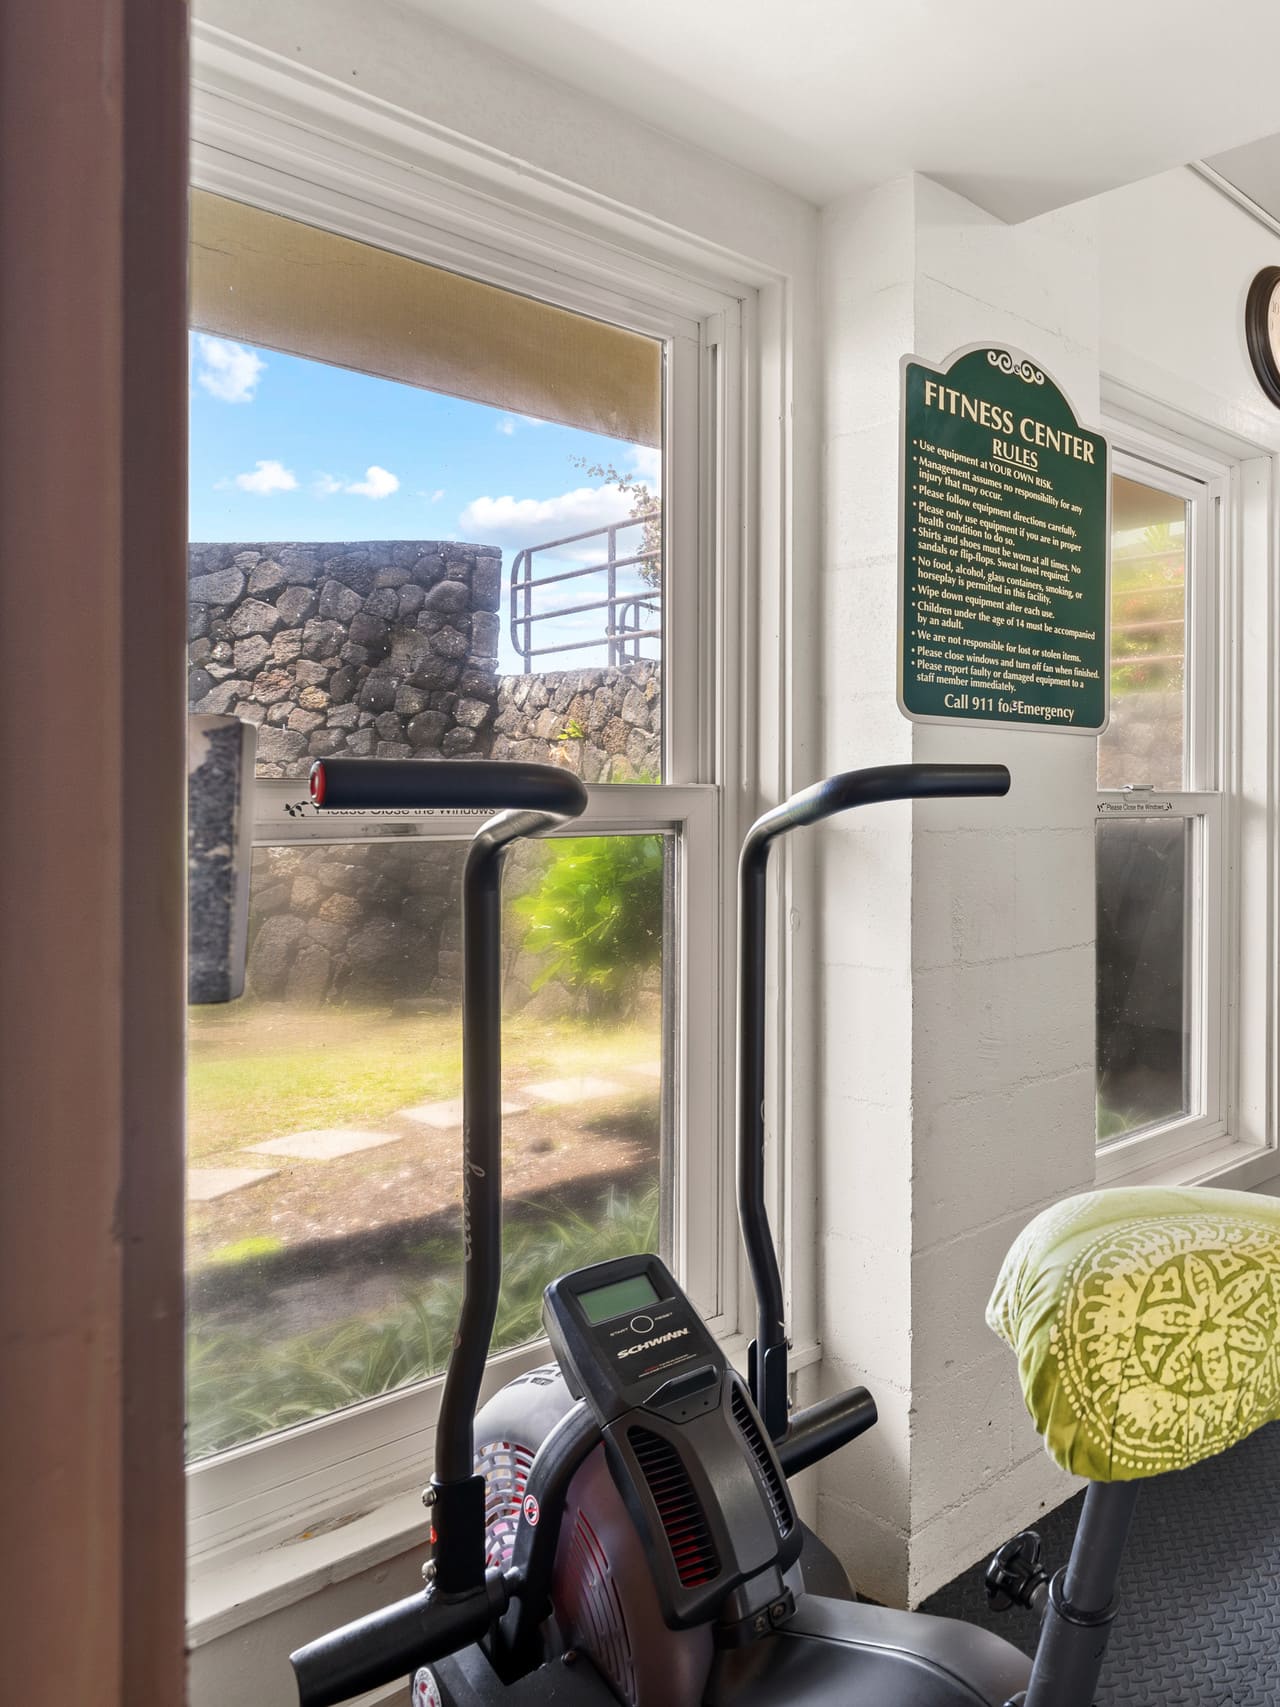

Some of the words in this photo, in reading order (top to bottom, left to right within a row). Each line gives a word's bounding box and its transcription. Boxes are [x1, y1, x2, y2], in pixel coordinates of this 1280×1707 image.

[925, 380, 1013, 434] FITNESS
[1019, 417, 1094, 464] CENTER
[919, 439, 935, 453] Use
[936, 447, 978, 467] equipment
[979, 461, 988, 470] at
[988, 461, 1012, 477] YOUR
[1013, 470, 1034, 484] OWN
[1035, 476, 1053, 490] RISK.
[992, 438, 1038, 468] RULES
[918, 467, 943, 486] injury
[944, 476, 960, 489] that
[961, 483, 978, 496] may
[979, 488, 1003, 501] occur.
[918, 455, 970, 480] Management
[971, 474, 1002, 489] assumes
[1003, 483, 1013, 492] no
[1014, 487, 1059, 508] responsibility
[1060, 498, 1070, 509] for
[1070, 504, 1082, 515] any
[918, 484, 944, 500] Please
[945, 491, 970, 507] follow
[972, 501, 1011, 519] equipment
[1012, 510, 1046, 528] directions
[918, 500, 944, 516] Please
[945, 510, 963, 523] only
[964, 515, 978, 525] use
[979, 519, 1018, 536] equipment
[1019, 527, 1025, 537] if
[1025, 531, 1039, 541] you
[1039, 535, 1051, 544] are
[1052, 535, 1059, 546] in
[1059, 540, 1082, 552] proper
[918, 512, 944, 528] health
[945, 522, 982, 538] condition
[983, 530, 992, 540] to
[993, 532, 1003, 543] do
[1004, 537, 1015, 546] so.
[917, 541, 948, 554] sandals
[949, 548, 958, 557] or
[997, 557, 1018, 571] Sweat
[1020, 563, 1039, 575] towel
[918, 526, 941, 541] Shirts
[942, 534, 958, 545] and
[959, 536, 981, 550] shoes
[982, 544, 1000, 555] must
[1001, 546, 1011, 557] be
[1012, 551, 1031, 562] worn
[1031, 555, 1039, 564] at
[1039, 556, 1049, 566] all
[1050, 559, 1070, 572] times.
[1070, 563, 1081, 574] No
[917, 567, 956, 587] horseplay
[958, 576, 965, 586] is
[966, 580, 1003, 594] permitted
[1003, 585, 1011, 595] in
[1012, 587, 1026, 598] this
[918, 555, 931, 567] No
[932, 558, 953, 574] food,
[955, 563, 986, 580] alcohol,
[987, 570, 1005, 586] glass
[1045, 585, 1074, 600] smoking,
[1074, 591, 1083, 599] or
[917, 584, 940, 599] Wipe
[940, 588, 963, 601] down
[964, 595, 1004, 610] equipment
[1005, 601, 1023, 612] after
[1023, 606, 1040, 616] each
[1041, 610, 1055, 619] use.
[917, 600, 952, 616] Children
[953, 609, 977, 619] under
[978, 611, 991, 622] the
[991, 615, 1005, 627] age
[1005, 616, 1014, 626] of
[1015, 618, 1025, 628] 14
[1025, 622, 1043, 631] must
[1043, 622, 1053, 633] be
[1053, 626, 1095, 640] accompanied
[917, 612, 927, 626] by
[929, 617, 940, 625] an
[941, 617, 964, 630] adult.
[917, 629, 931, 640] We
[932, 634, 946, 643] are
[947, 636, 961, 645] not
[962, 638, 1005, 651] responsible
[1005, 642, 1017, 653] for
[1017, 644, 1031, 655] lost
[1031, 648, 1040, 656] or
[1041, 649, 1061, 659] stolen
[1062, 650, 1081, 662] items.
[917, 645, 943, 658] Please
[944, 649, 964, 661] close
[966, 652, 999, 665] windows
[1000, 658, 1014, 667] and
[1015, 659, 1030, 669] turn
[1031, 661, 1042, 671] off
[1042, 662, 1054, 672] fan
[1054, 664, 1073, 675] when
[916, 672, 935, 682] staff
[936, 675, 969, 686] member
[917, 659, 942, 671] Please
[944, 664, 968, 677] report
[970, 665, 992, 679] faulty
[992, 670, 1001, 678] or
[1002, 669, 1034, 684] damaged
[1035, 675, 1071, 687] equipment
[1071, 679, 1079, 688] to
[944, 693, 968, 709] Call
[971, 696, 993, 711] 911
[1016, 700, 1074, 722] Emergency
[617, 1327, 690, 1360] SCHWINN
